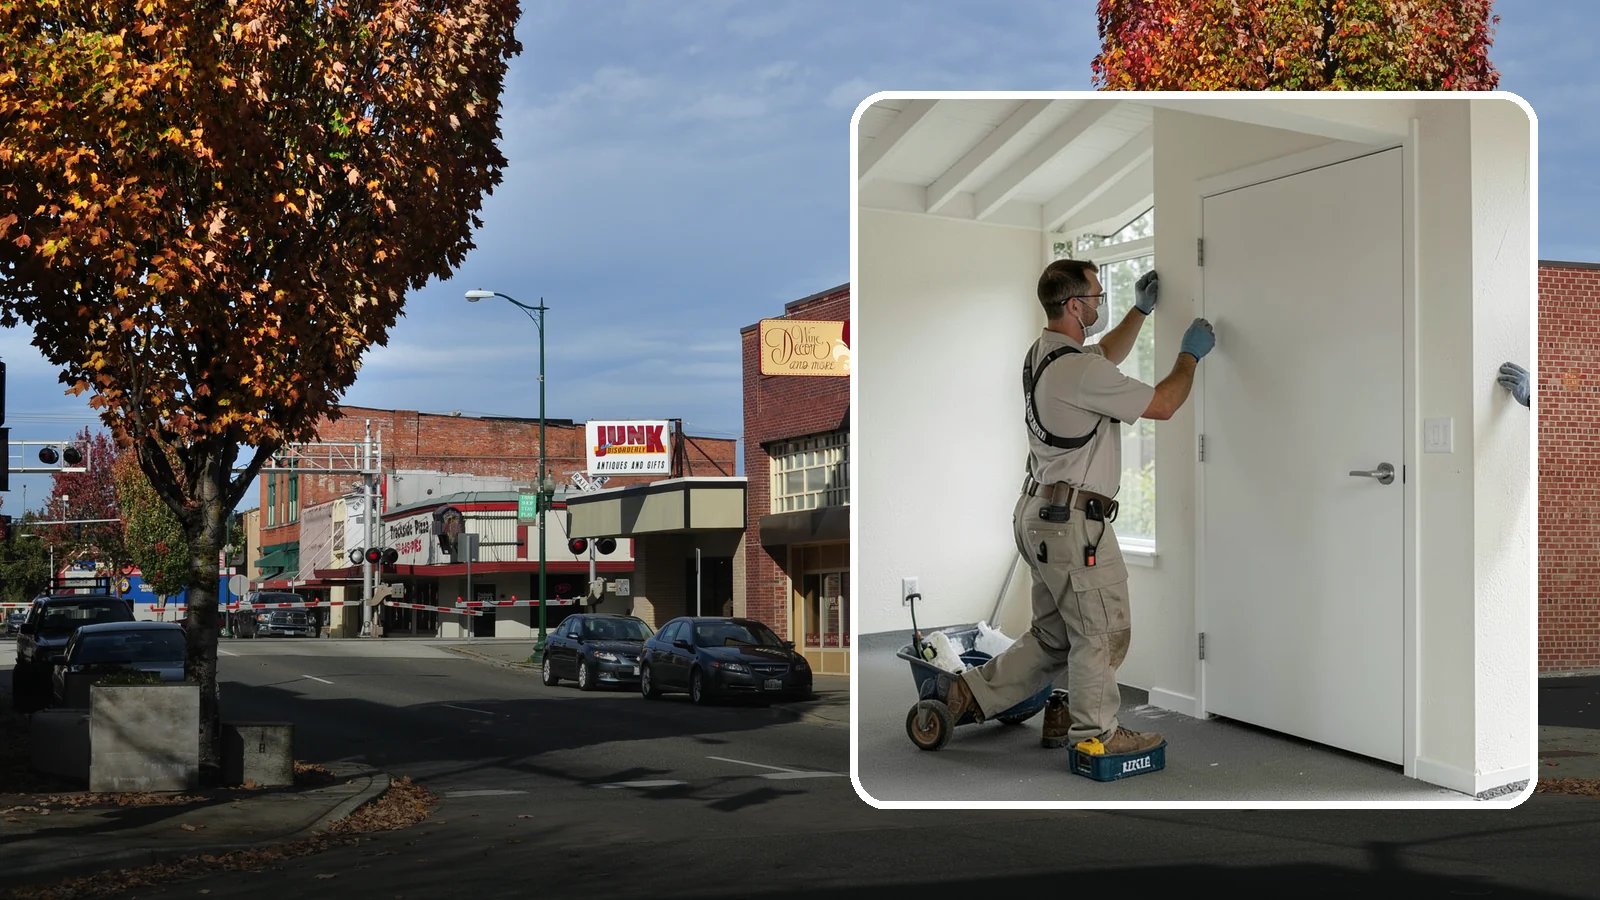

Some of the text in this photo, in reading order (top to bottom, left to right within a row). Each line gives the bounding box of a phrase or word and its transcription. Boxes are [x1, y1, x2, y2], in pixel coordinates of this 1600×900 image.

[595, 425, 665, 457] JUNK
[607, 446, 645, 454] DISORDERLY
[597, 460, 665, 470] ANTIQUES AND GIFTS
[352, 498, 365, 511] CRO
[390, 519, 429, 540] Trackside Pizza
